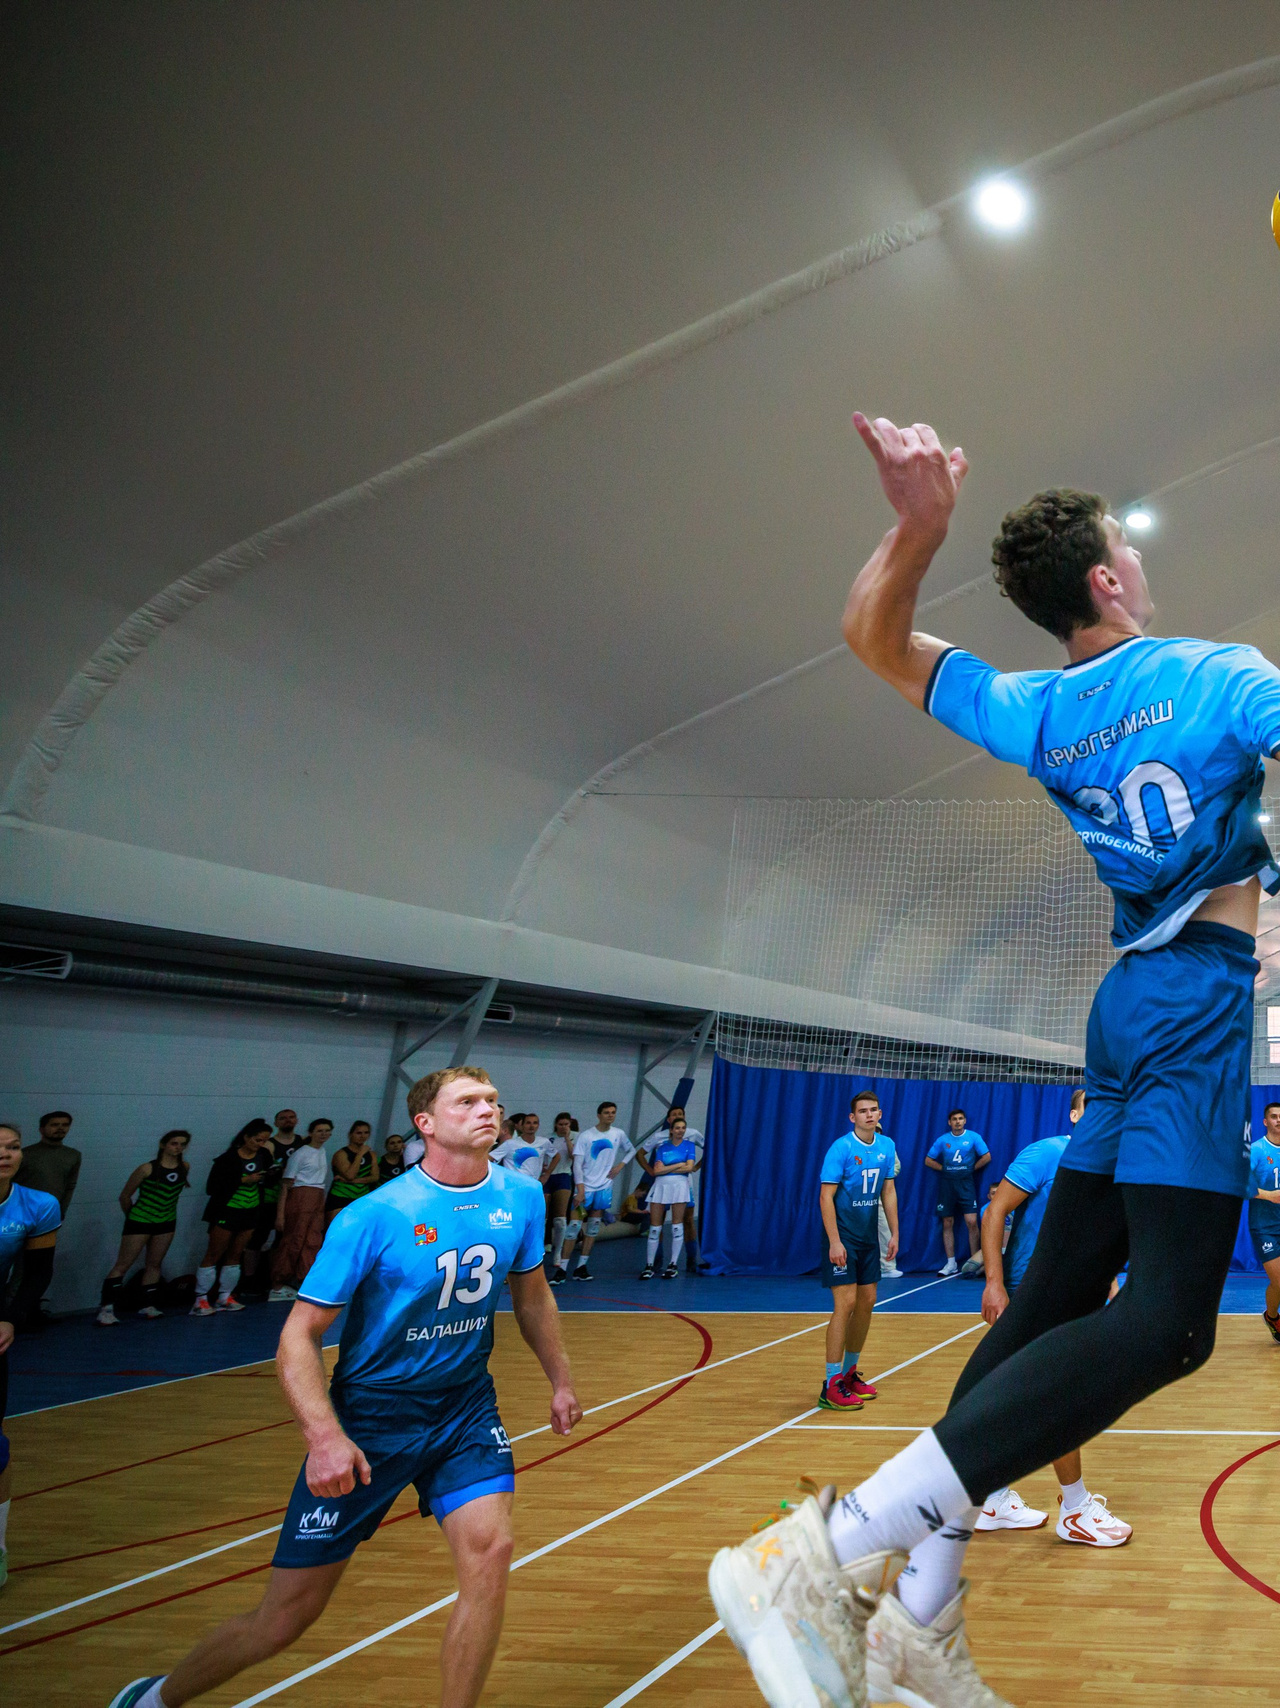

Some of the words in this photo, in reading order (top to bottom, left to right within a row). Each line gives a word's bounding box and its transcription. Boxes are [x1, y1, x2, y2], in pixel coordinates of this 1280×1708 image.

[952, 1149, 963, 1164] 4
[861, 1168, 880, 1194] 17
[436, 1243, 497, 1310] 13
